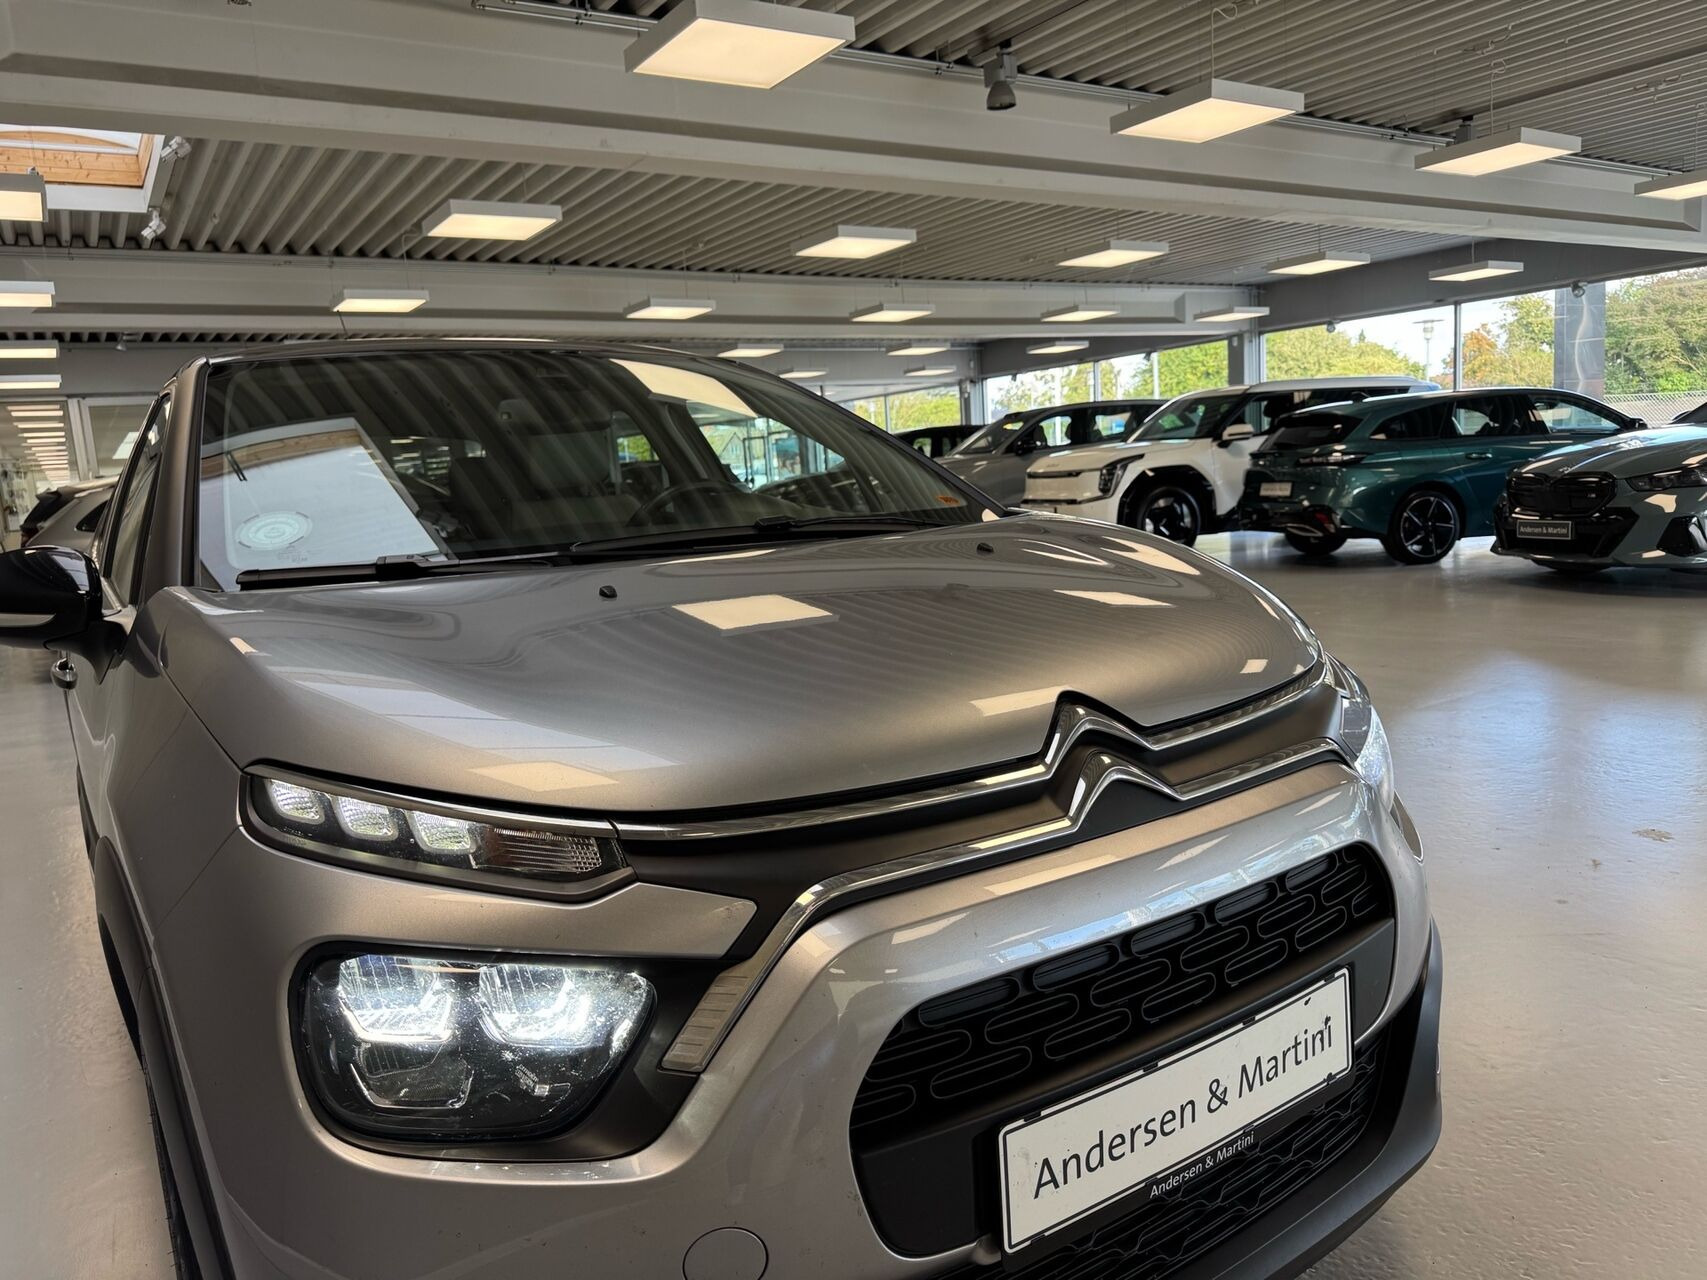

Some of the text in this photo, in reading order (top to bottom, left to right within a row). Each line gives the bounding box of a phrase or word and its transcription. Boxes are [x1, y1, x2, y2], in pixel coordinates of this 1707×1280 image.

[1033, 1015, 1333, 1200] Andersen & Martini
[1149, 1130, 1255, 1200] Andersen & Martini
